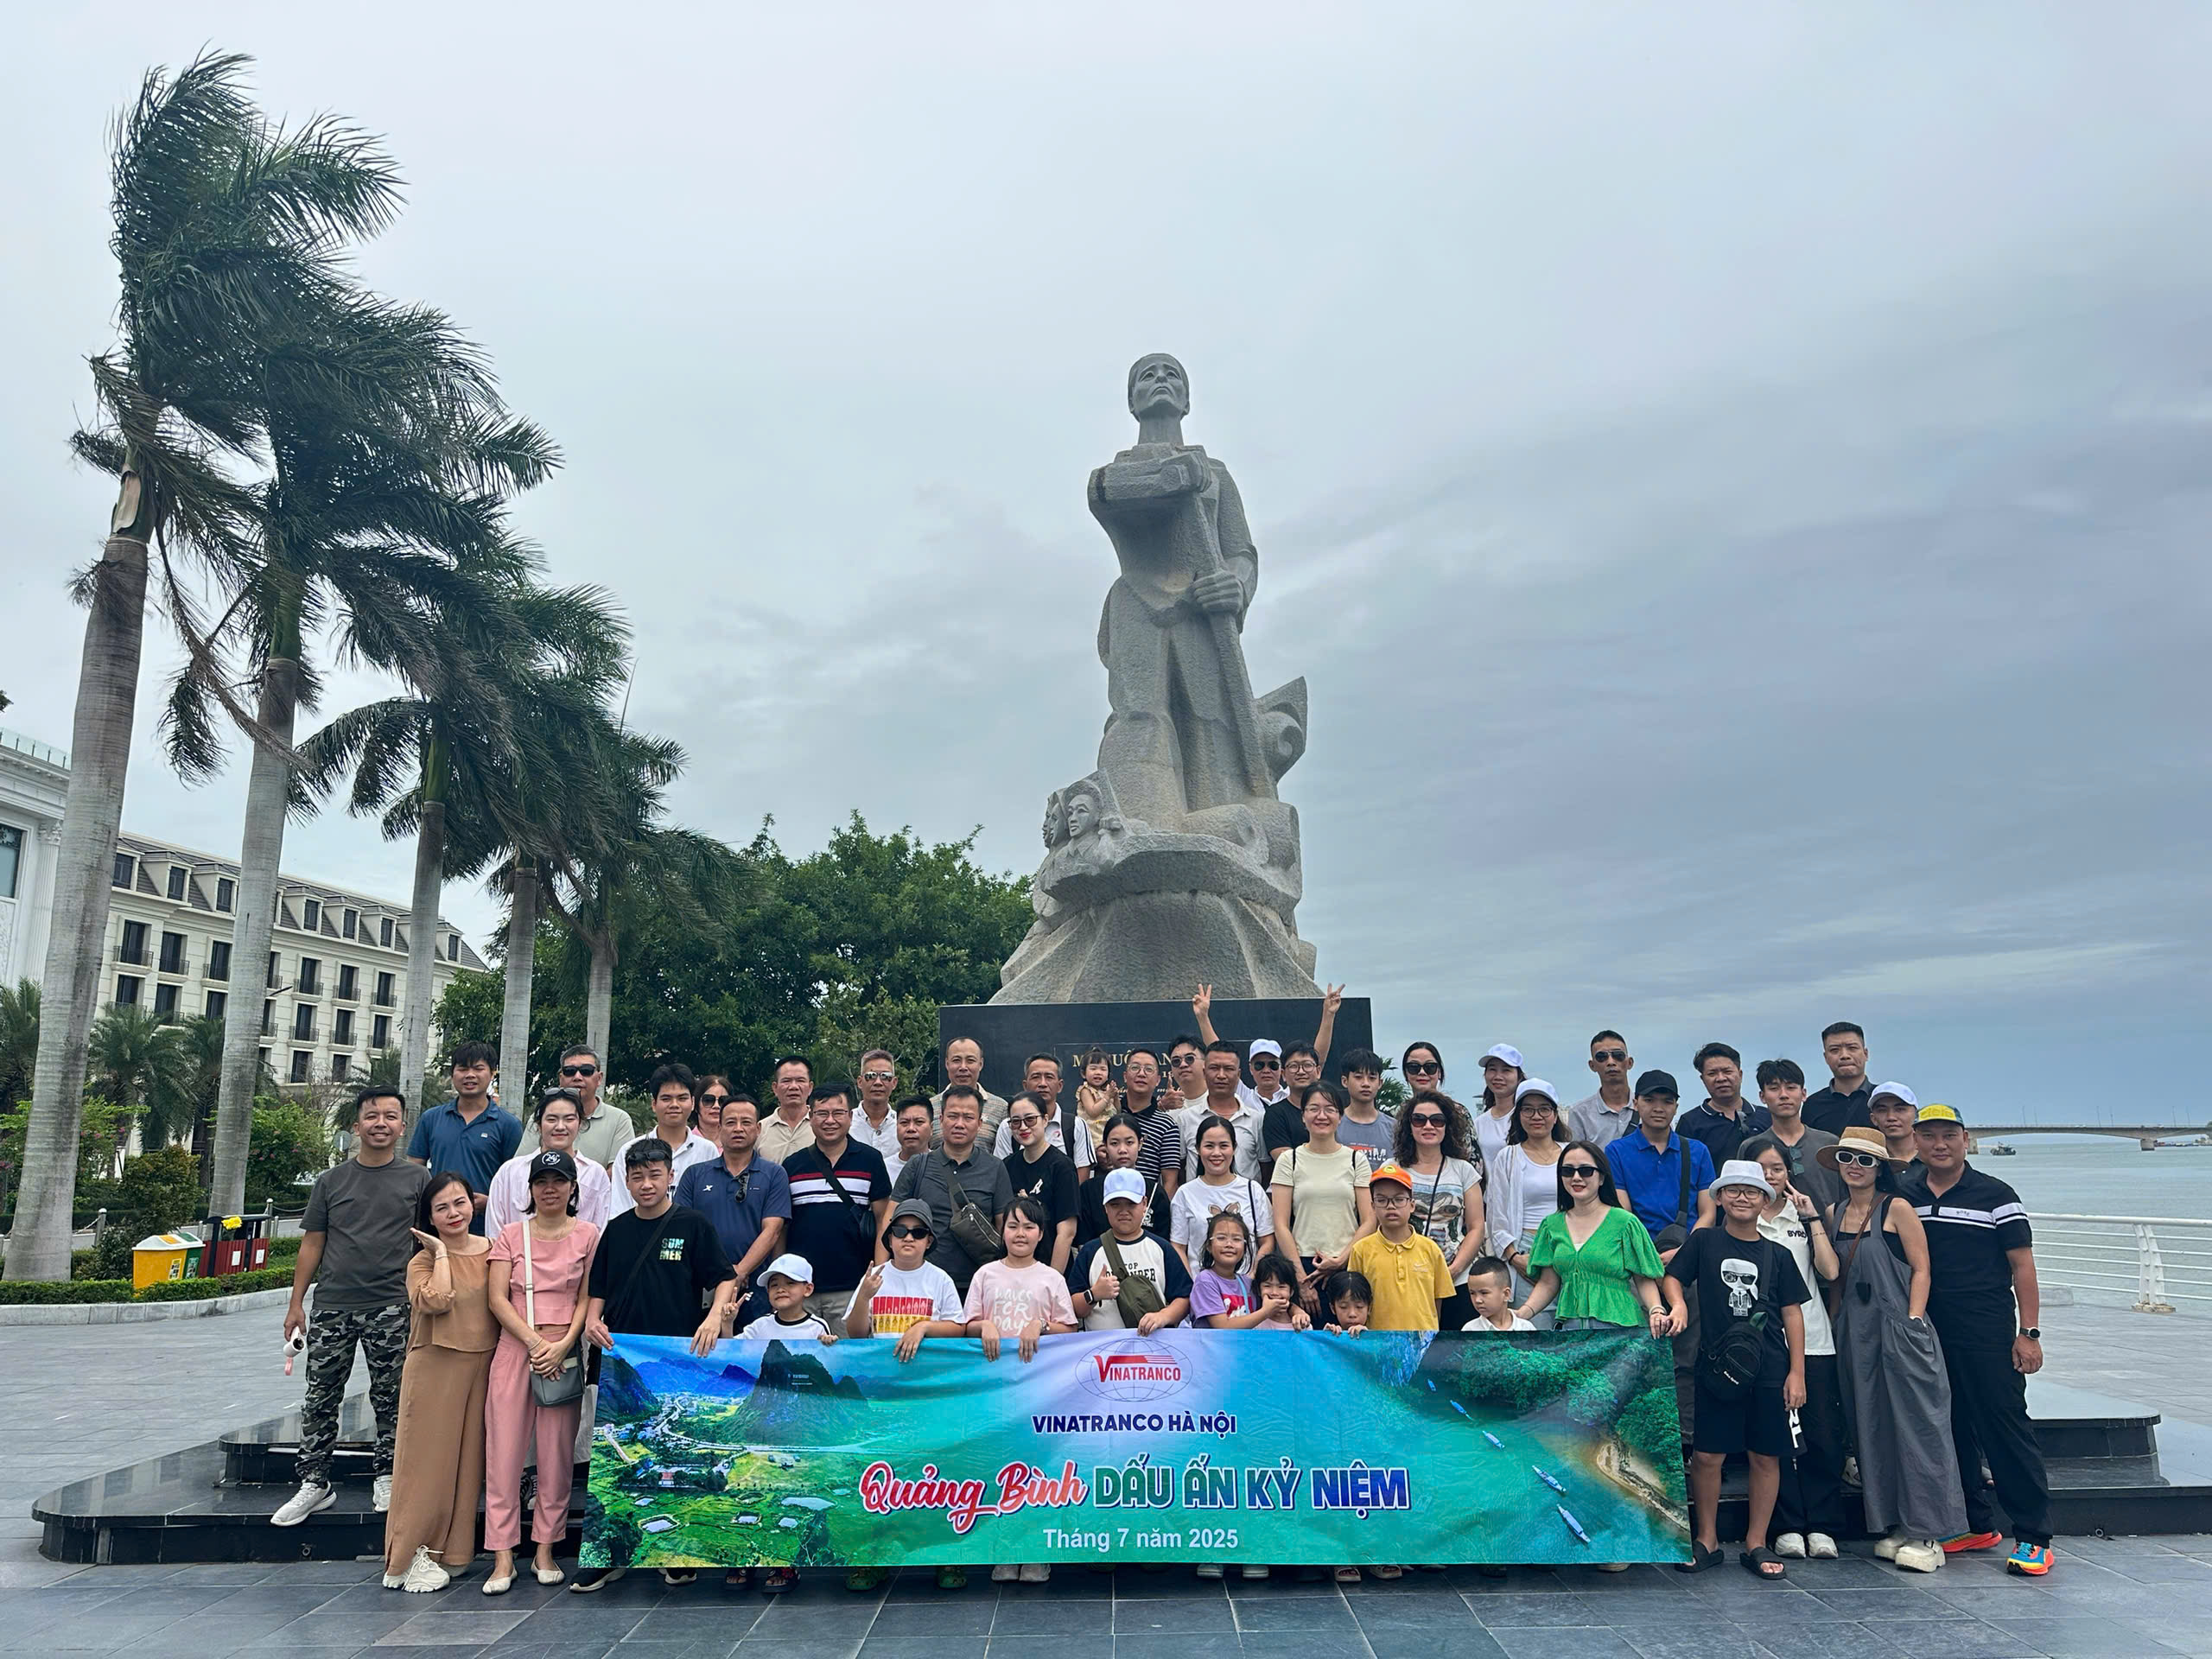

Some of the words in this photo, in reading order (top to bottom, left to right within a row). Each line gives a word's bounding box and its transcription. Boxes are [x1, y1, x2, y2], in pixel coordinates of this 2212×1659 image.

[1093, 1355, 1181, 1382] VINATRANCO
[1032, 1414, 1164, 1433] VINATRANCO
[1167, 1410, 1196, 1433] HÀ
[1199, 1410, 1236, 1439] NỘI
[859, 1460, 999, 1534] Quảng
[996, 1459, 1090, 1515] Bình
[1093, 1452, 1175, 1510] DẤU
[1182, 1452, 1238, 1510] ẤN
[1244, 1456, 1303, 1510] KỶ
[1310, 1459, 1412, 1520] NIỆM
[1043, 1527, 1110, 1553] Tháng
[1117, 1528, 1129, 1548] 7
[1136, 1527, 1182, 1548] năm
[1188, 1528, 1238, 1548] 2025
